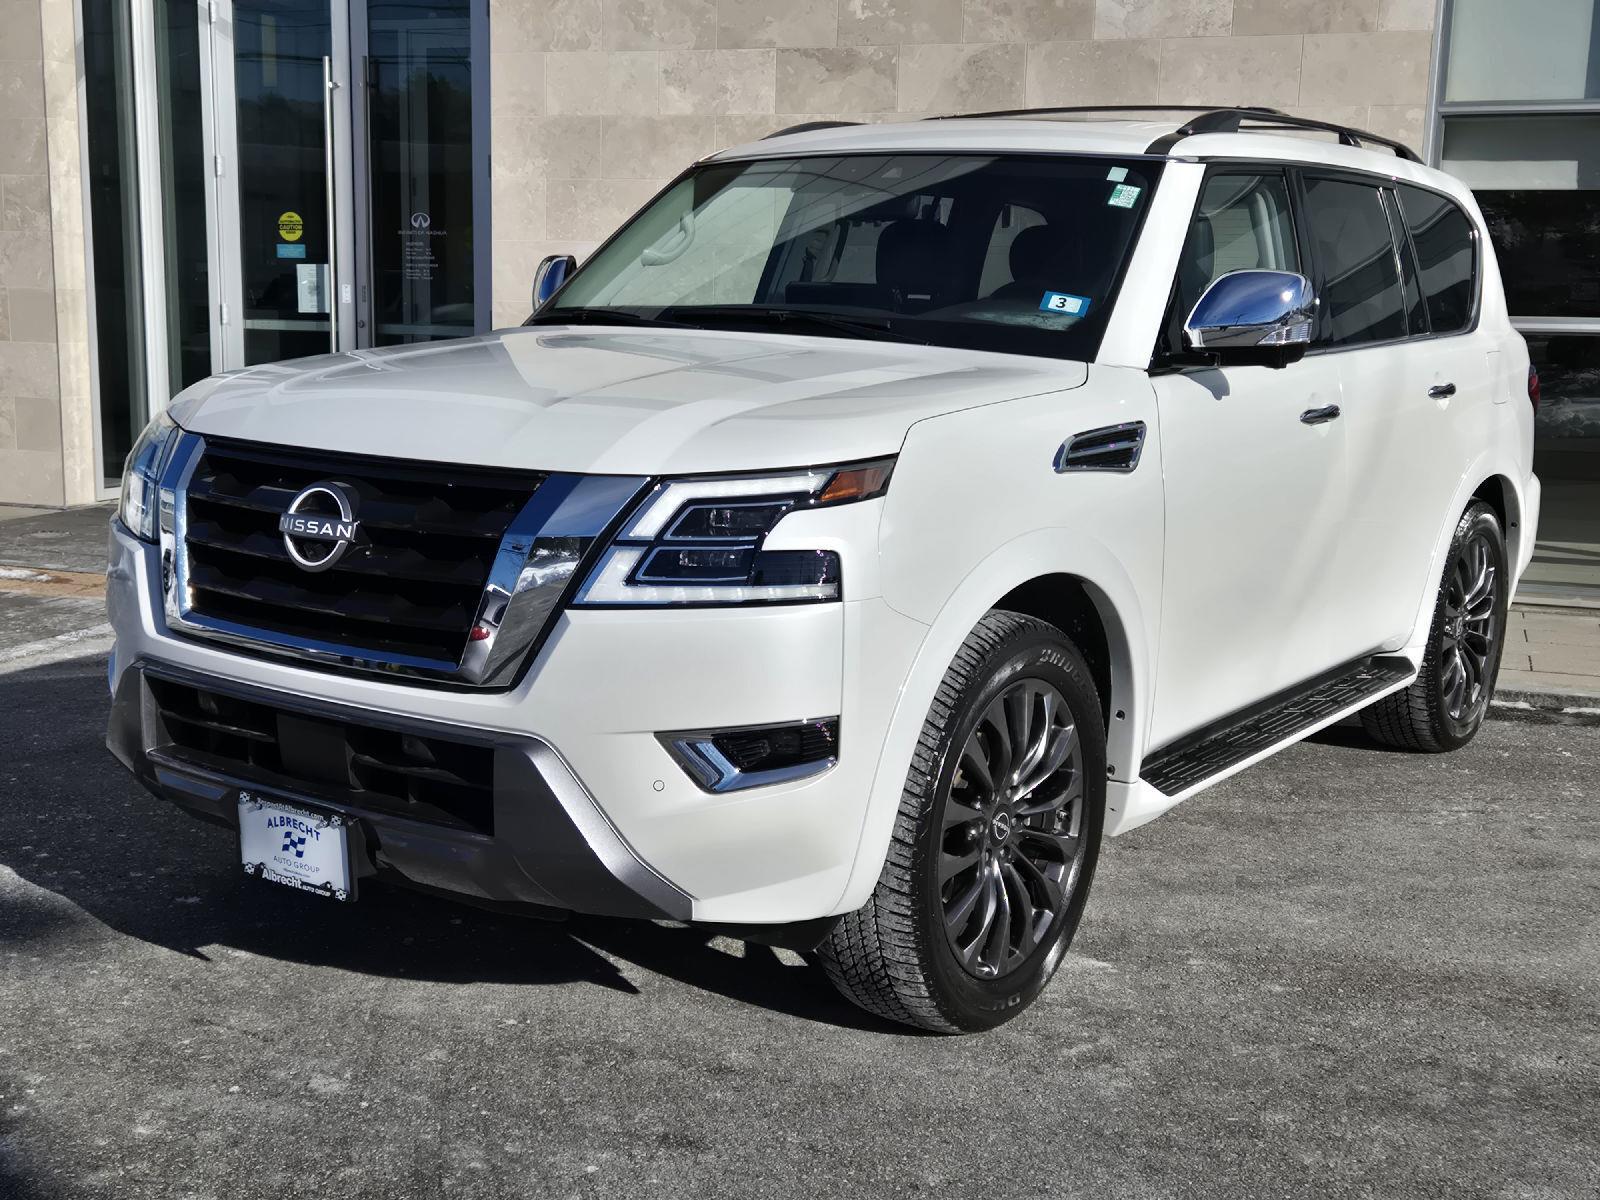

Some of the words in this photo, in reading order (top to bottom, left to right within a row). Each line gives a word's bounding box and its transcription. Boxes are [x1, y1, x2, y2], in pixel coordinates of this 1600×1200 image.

[1055, 297, 1067, 309] 3
[280, 516, 352, 538] NISSAN
[267, 816, 320, 841] ALBRECHT
[273, 855, 292, 867] AUTO
[293, 861, 320, 873] GROUP
[262, 868, 303, 890] Albrecht
